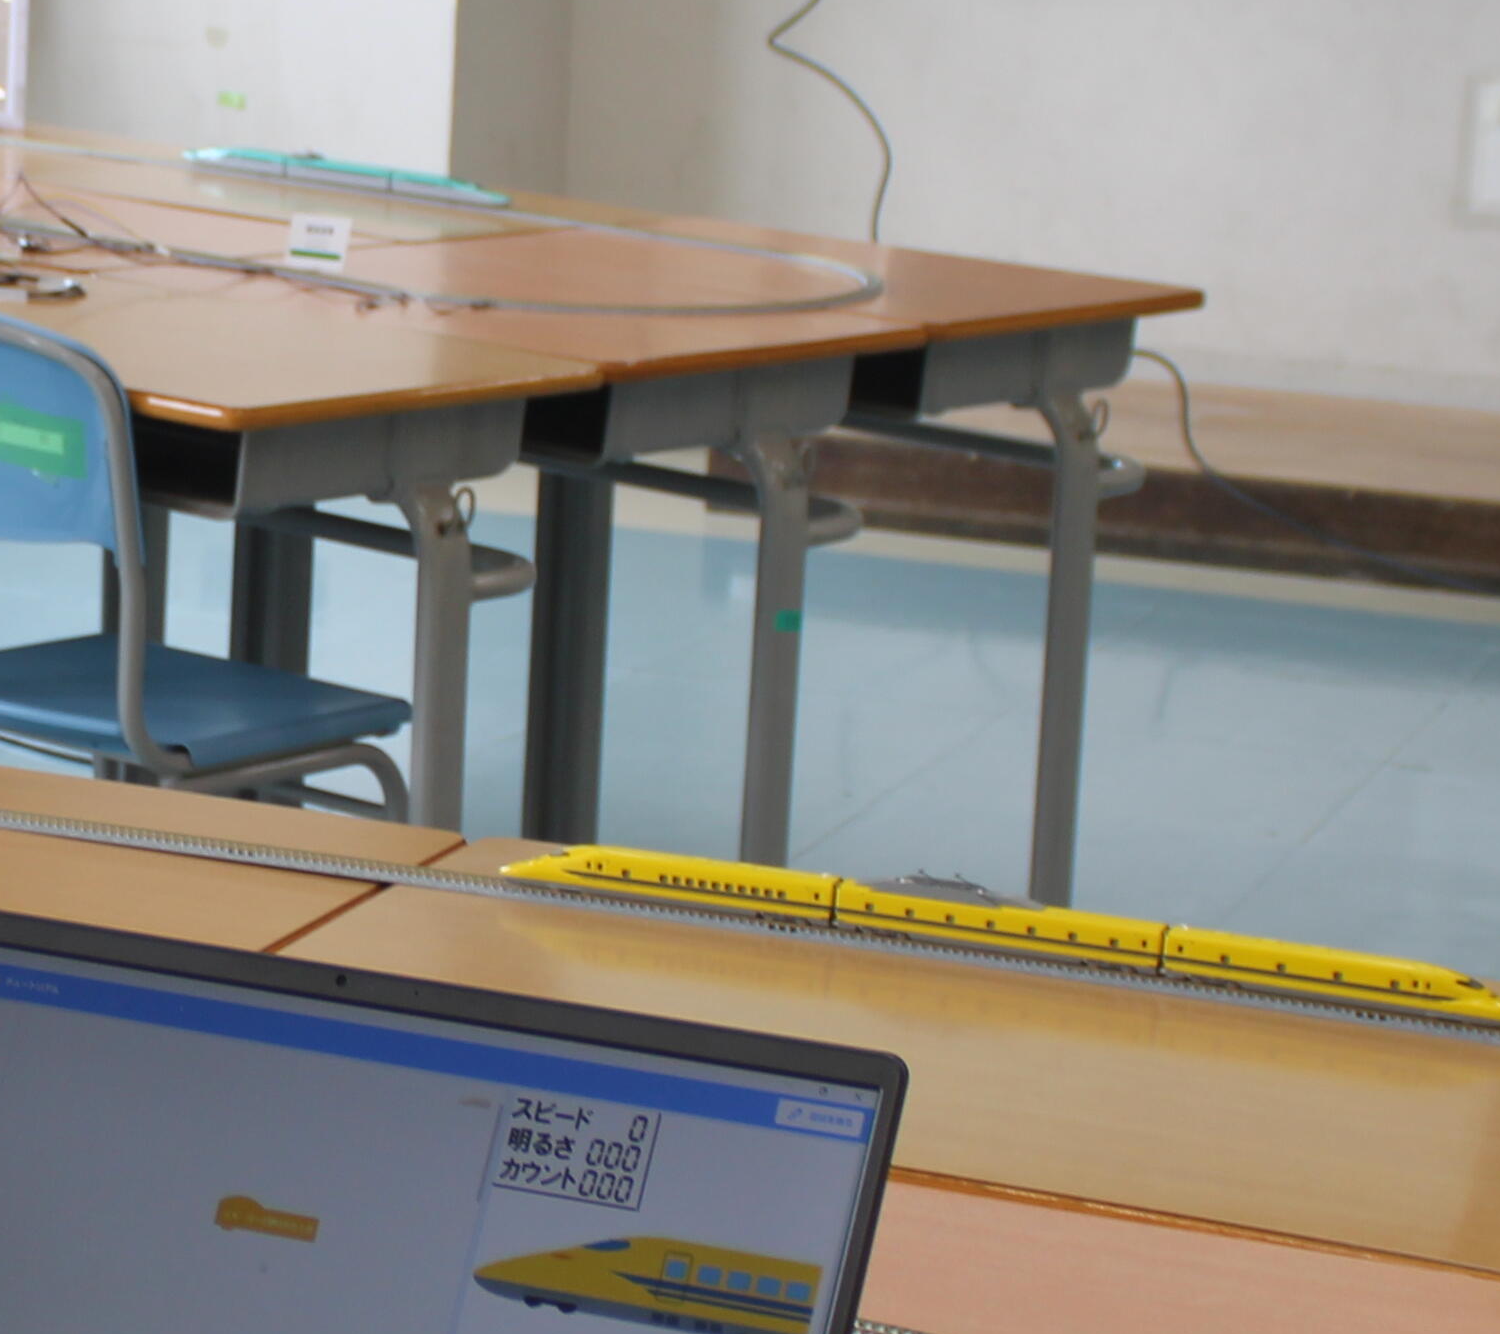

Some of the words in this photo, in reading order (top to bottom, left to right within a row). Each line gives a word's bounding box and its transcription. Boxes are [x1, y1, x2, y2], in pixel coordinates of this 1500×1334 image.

[512, 1098, 594, 1130] スピード
[628, 1114, 649, 1143] 0
[507, 1127, 576, 1160] 明るさ
[586, 1138, 641, 1173] 000
[499, 1157, 577, 1190] カウント
[578, 1169, 634, 1204] 000
